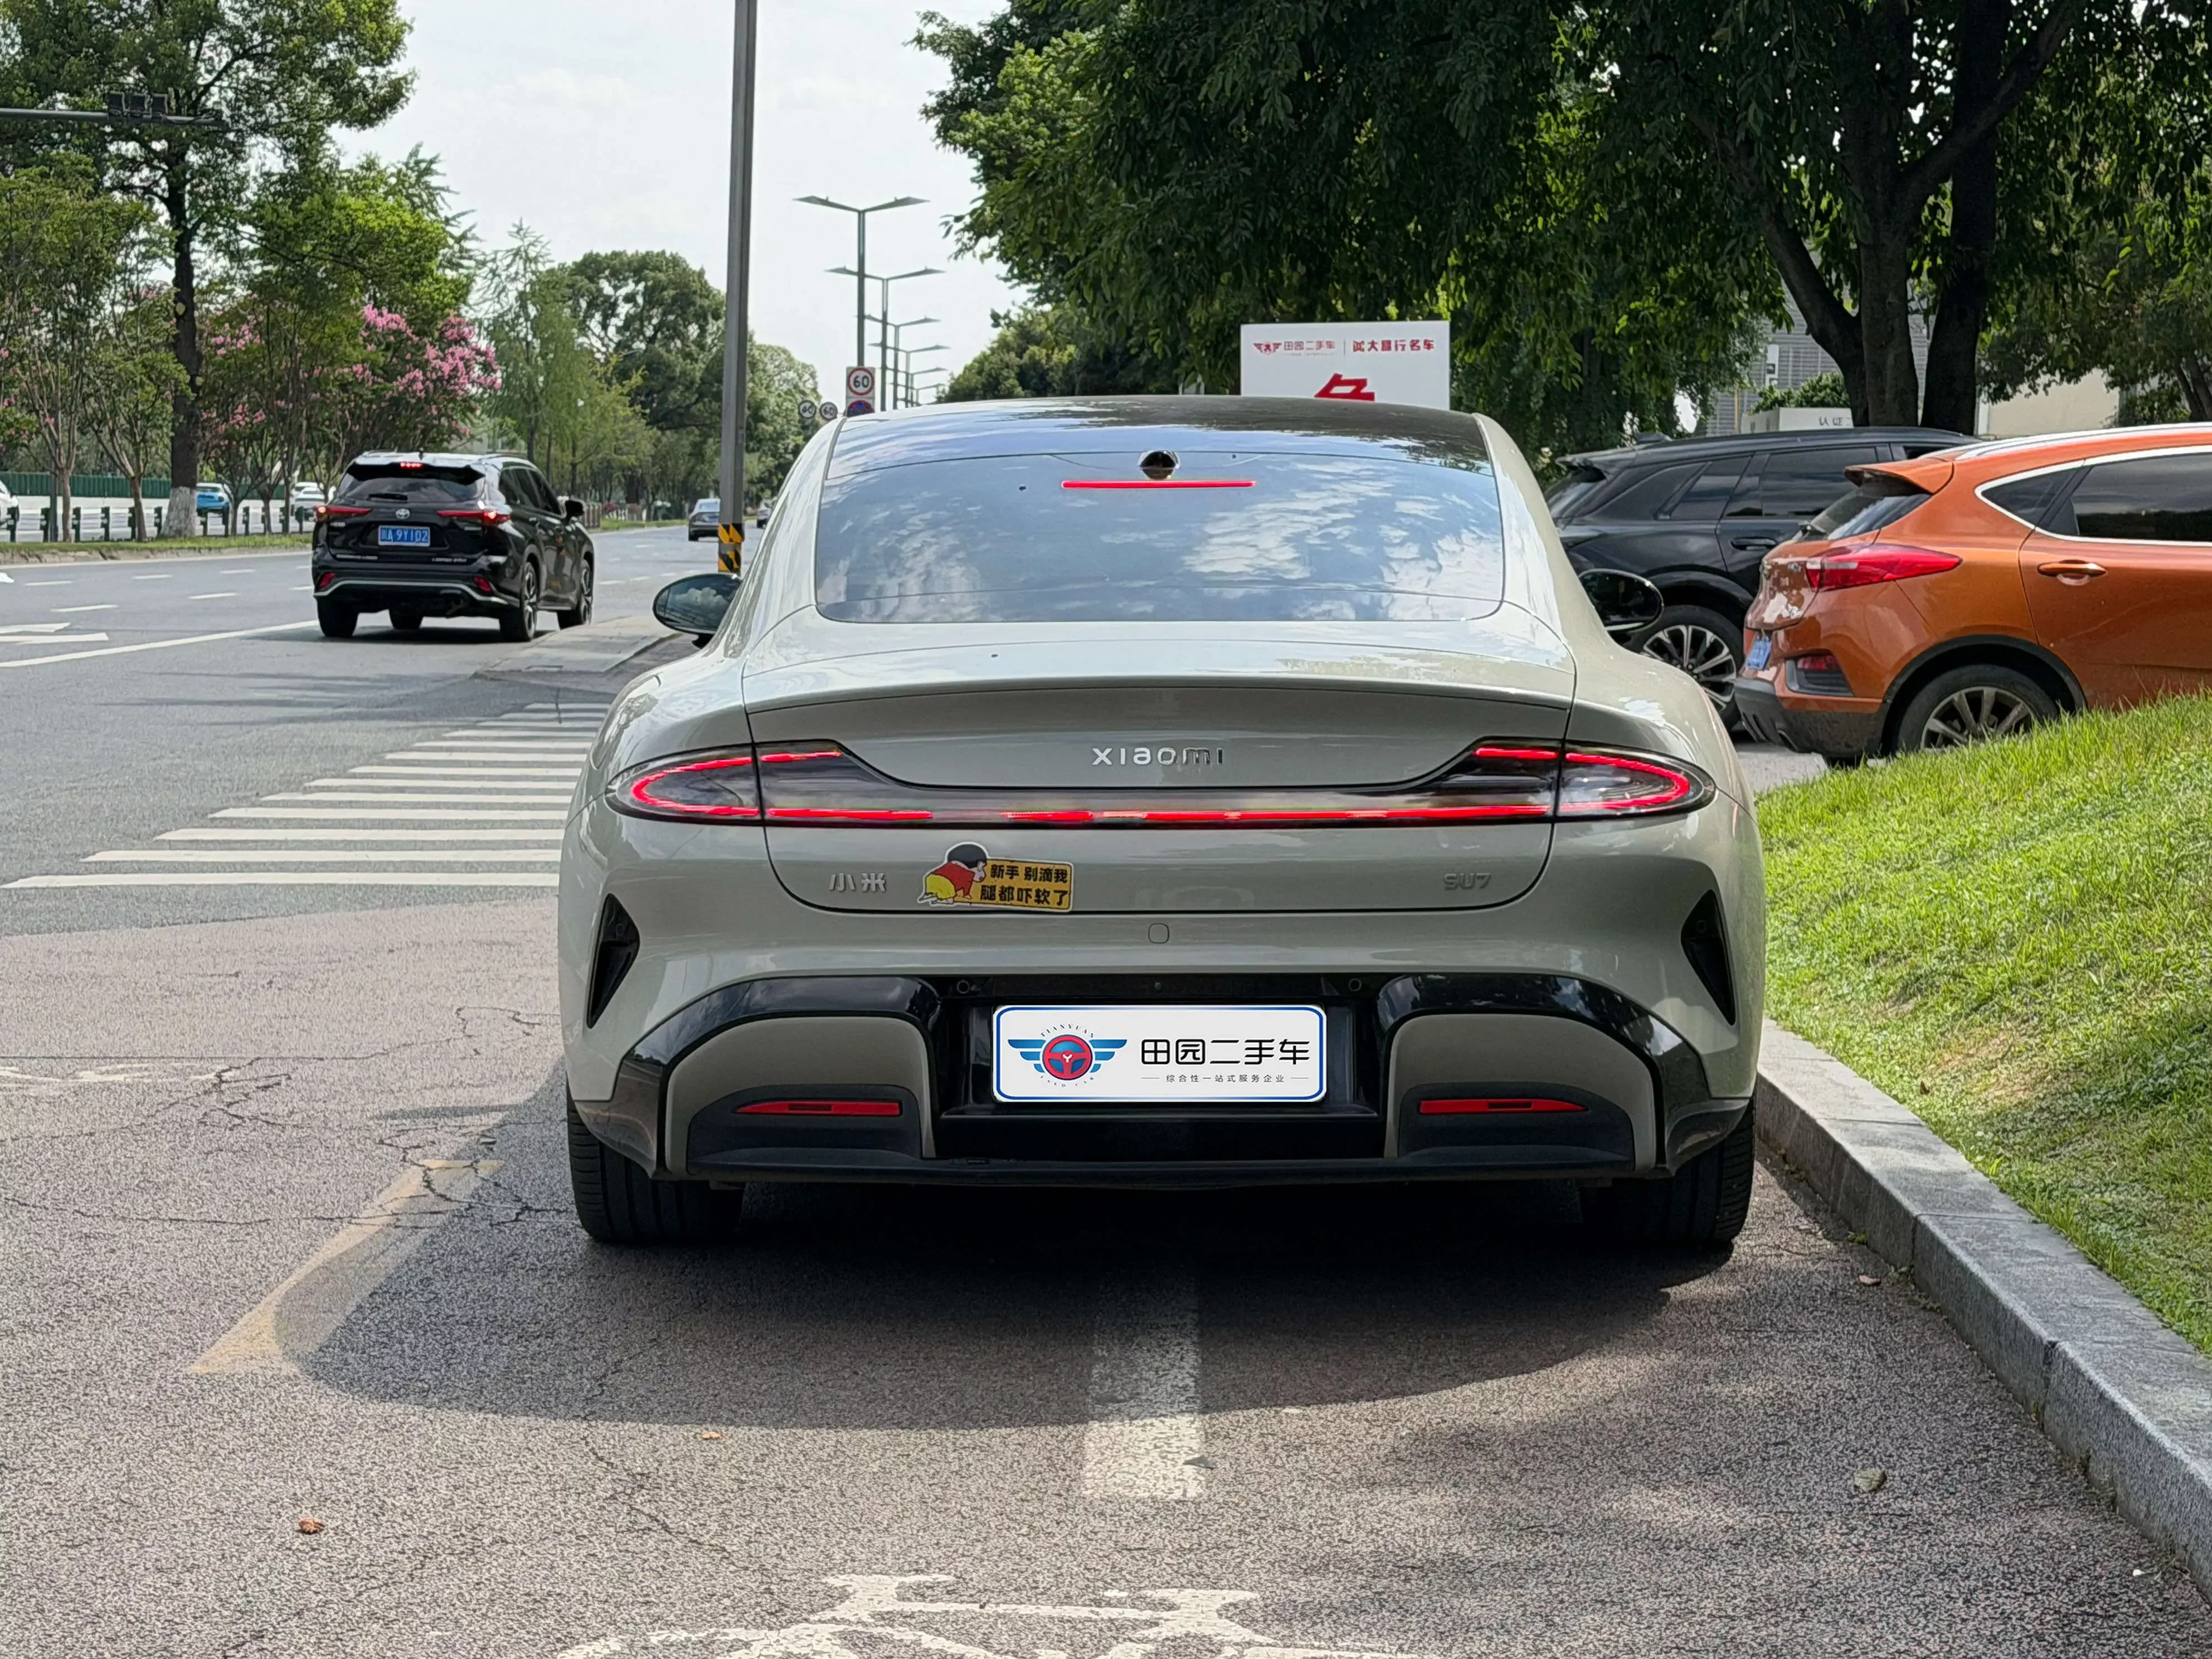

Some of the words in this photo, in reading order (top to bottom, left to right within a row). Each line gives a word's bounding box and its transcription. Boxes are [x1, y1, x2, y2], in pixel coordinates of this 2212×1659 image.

[853, 375, 869, 388] 60
[829, 873, 887, 892] 小米
[990, 864, 1019, 880] 新手
[1023, 866, 1068, 884] 别滴我
[1443, 872, 1491, 891] SU7
[980, 884, 1068, 906] 腿都吓软了
